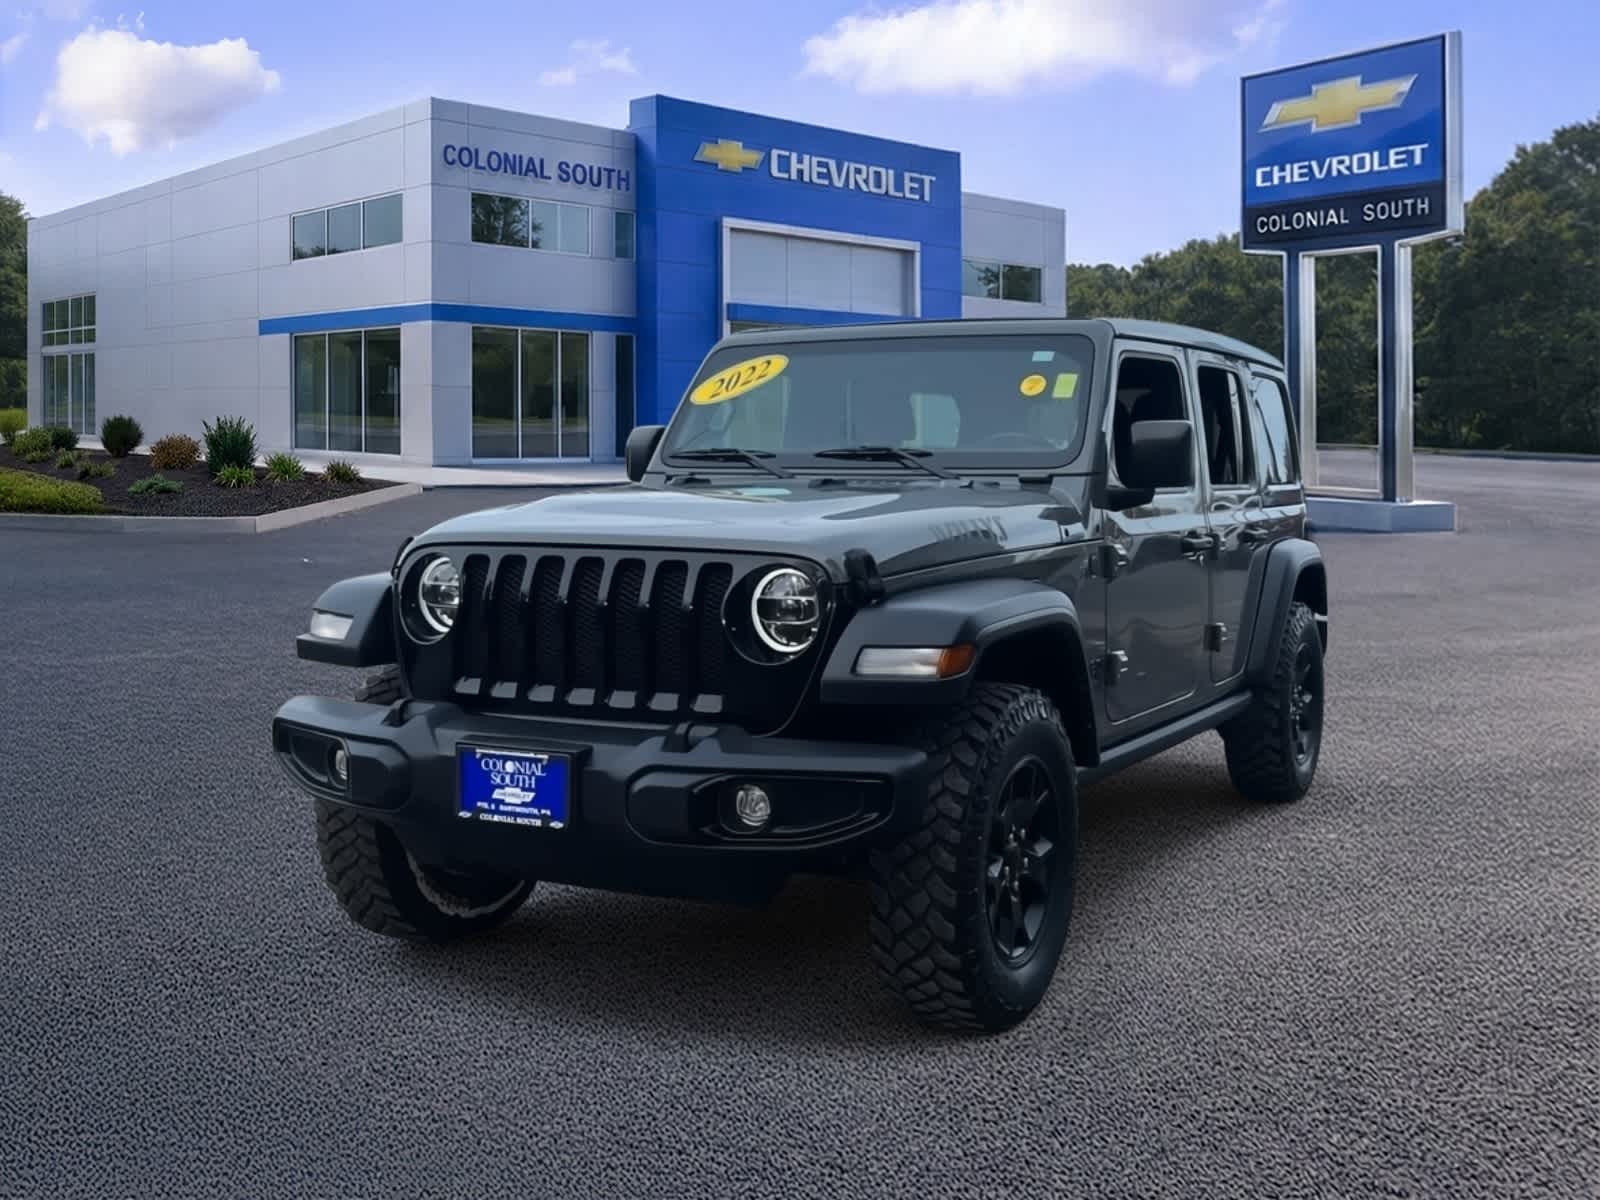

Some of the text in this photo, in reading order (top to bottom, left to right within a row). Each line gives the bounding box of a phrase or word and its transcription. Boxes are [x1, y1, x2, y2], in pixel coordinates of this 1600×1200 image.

[443, 144, 630, 192] COLONIAL SOUTH
[770, 148, 936, 203] CHEVROLET
[1255, 143, 1429, 188] CHEVROLET
[1256, 197, 1430, 234] COLONIAL SOUTH
[709, 359, 772, 400] 2022
[480, 758, 547, 776] COLONIAL
[490, 772, 536, 788] SOUTH
